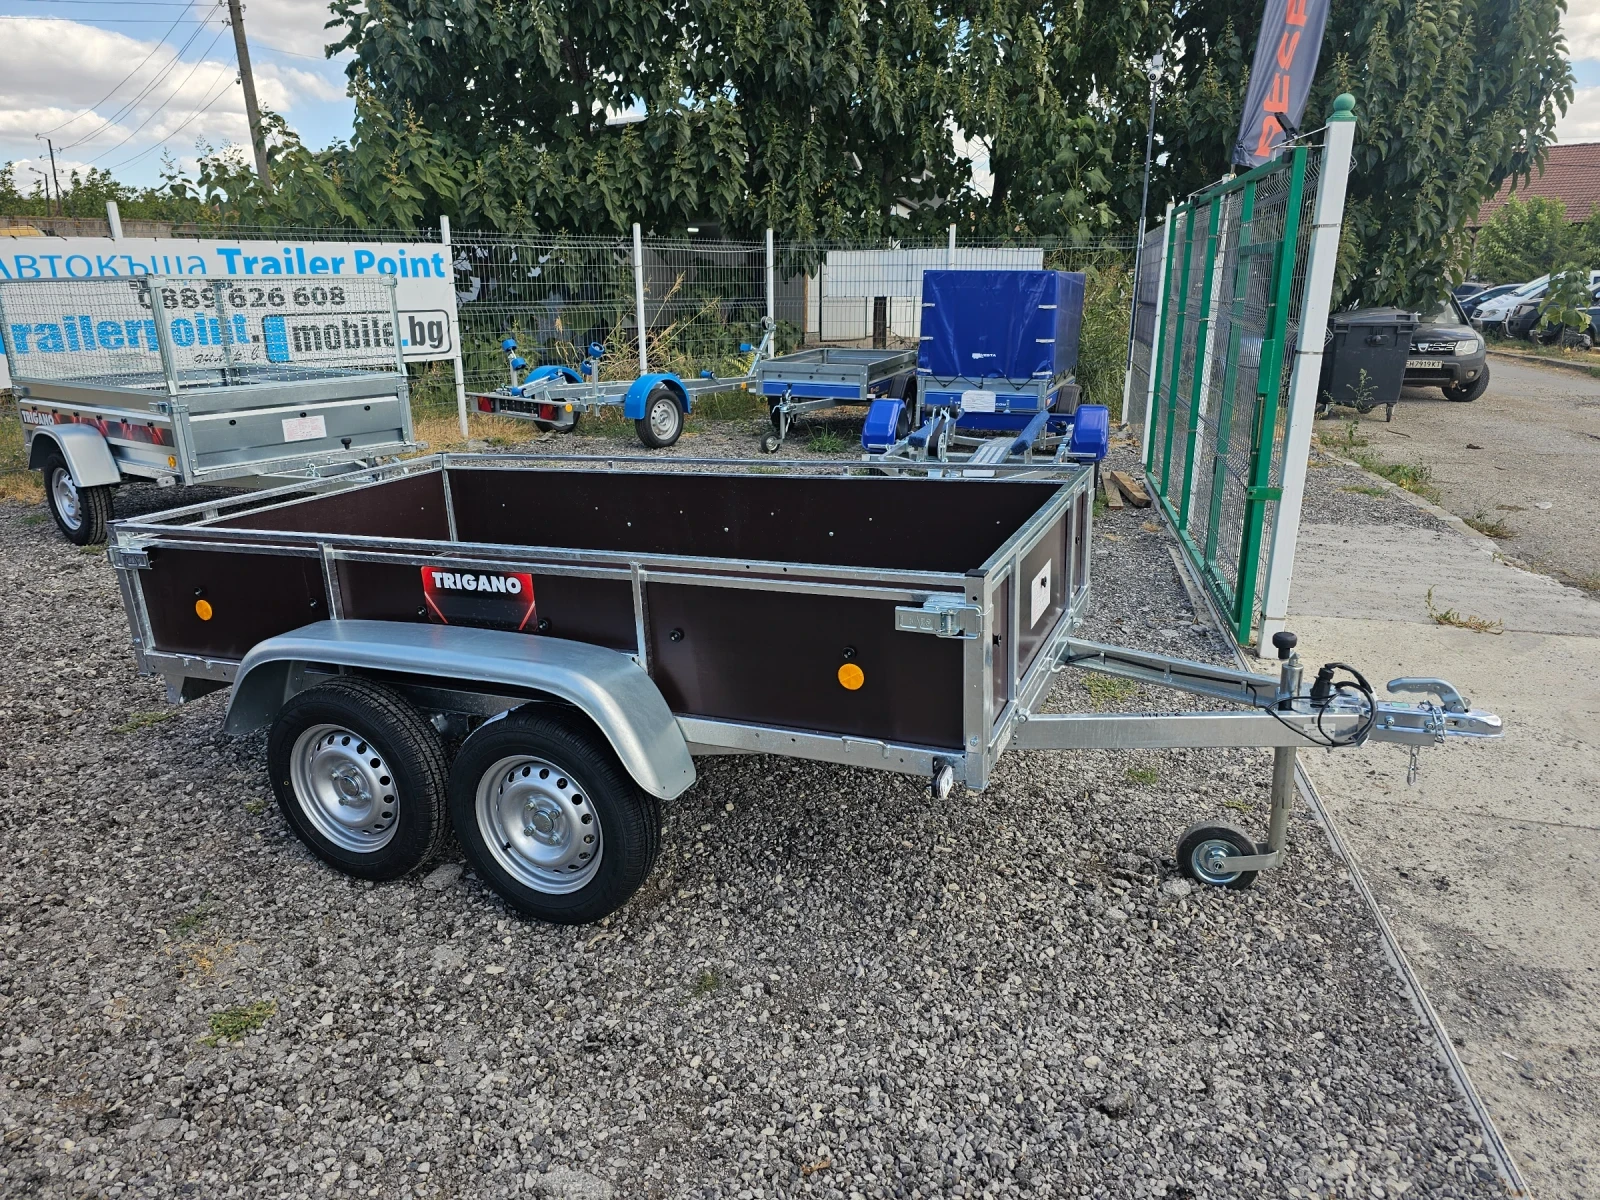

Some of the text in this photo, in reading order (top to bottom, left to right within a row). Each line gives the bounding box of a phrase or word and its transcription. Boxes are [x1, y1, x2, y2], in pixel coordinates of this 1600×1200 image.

[216, 247, 345, 275] Trailer
[354, 249, 446, 278] Point
[228, 287, 286, 308] 626
[292, 286, 346, 307] 608
[21, 410, 54, 426] TRIGANO
[431, 571, 522, 594] TRIGANO
